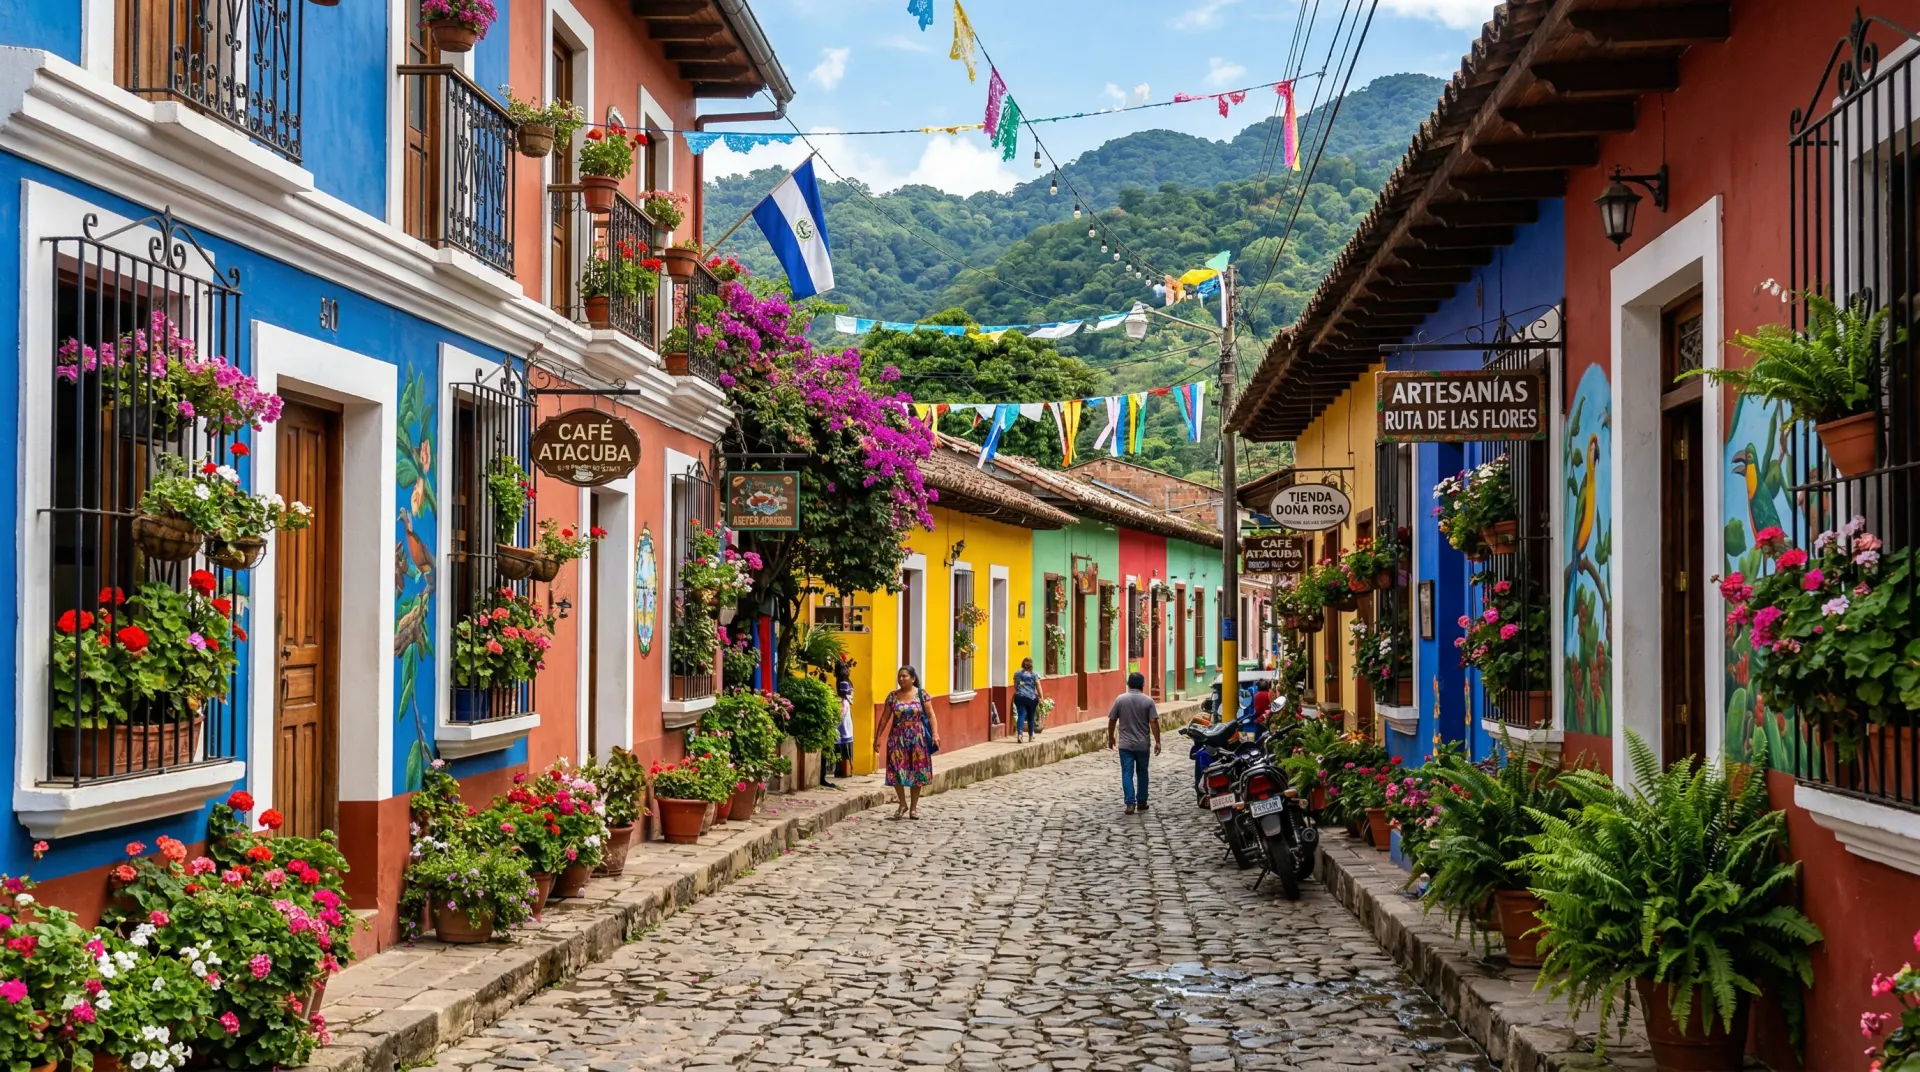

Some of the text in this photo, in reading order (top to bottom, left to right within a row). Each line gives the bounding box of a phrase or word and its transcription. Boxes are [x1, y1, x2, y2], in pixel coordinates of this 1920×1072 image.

[1391, 375, 1529, 404] ARTESANÍAS
[1384, 408, 1538, 431] RUTA DE LAS FLORES
[558, 419, 613, 442] CAFÉ
[538, 443, 632, 462] ATACUBA
[1288, 491, 1333, 503] TIENDA
[1276, 501, 1345, 515] DOÑA ROSA
[1260, 539, 1293, 548] CAFE
